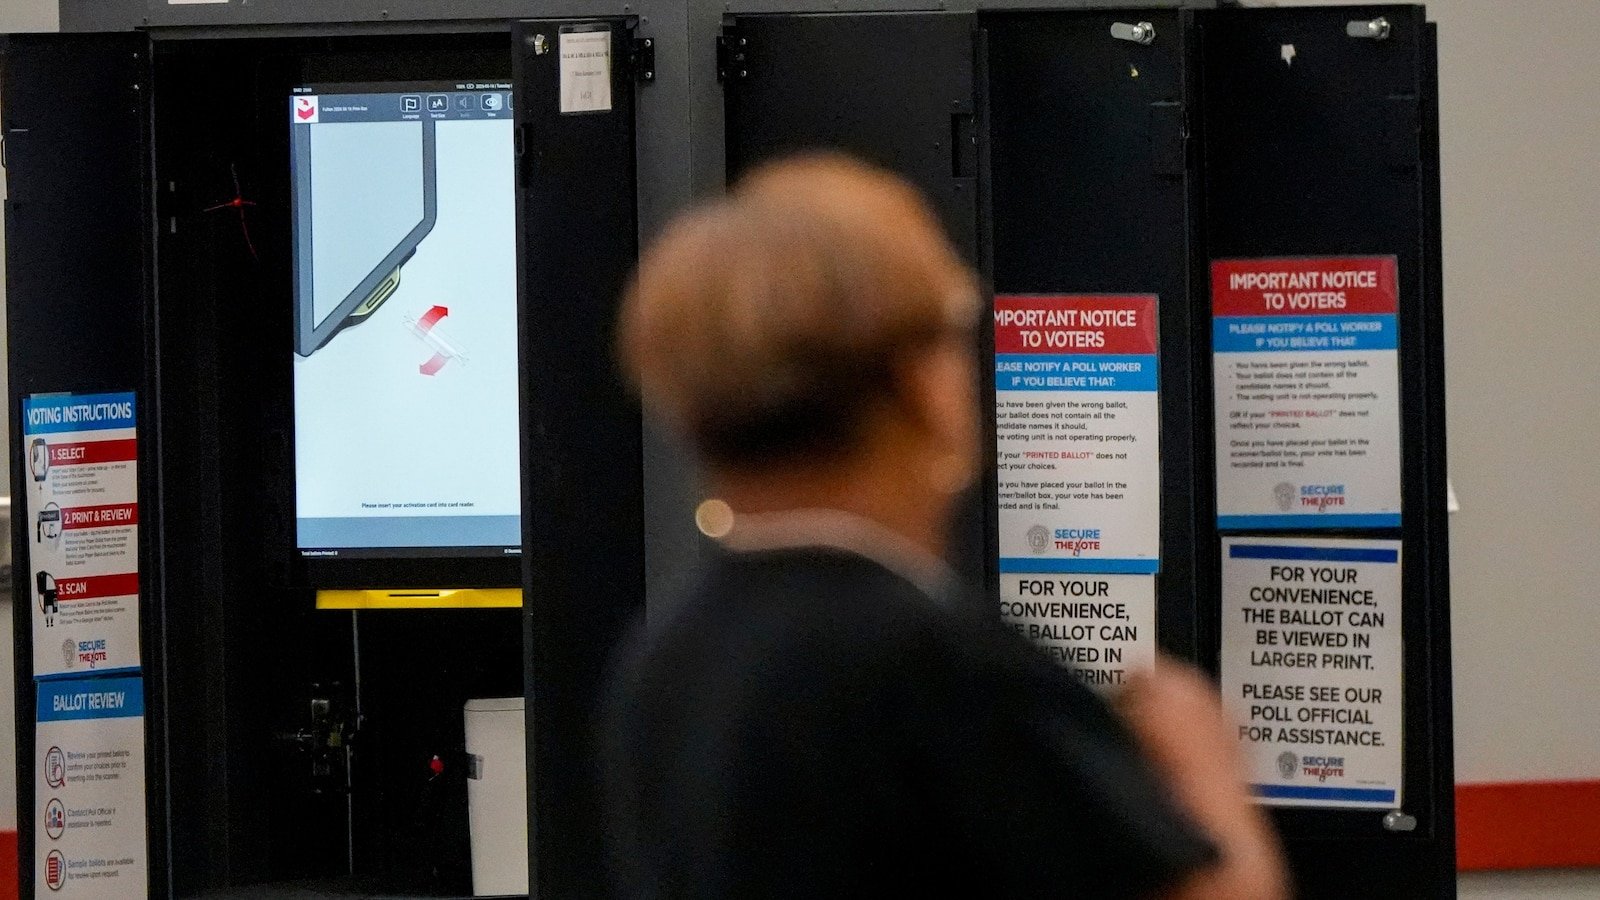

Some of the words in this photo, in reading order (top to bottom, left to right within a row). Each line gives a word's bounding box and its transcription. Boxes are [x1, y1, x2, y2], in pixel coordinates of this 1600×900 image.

[1230, 272, 1318, 290] IMPORTANT
[1322, 271, 1377, 288] NOTICE
[1263, 292, 1284, 310] TO
[1288, 292, 1346, 309] VOTERS
[994, 309, 1077, 327] MPORTANT
[1080, 310, 1136, 327] NOTICE
[1229, 323, 1266, 334] PLEASE
[1268, 322, 1304, 333] NOTIFY
[1306, 322, 1314, 332] A
[1314, 322, 1338, 332] POLL
[1340, 322, 1382, 332] WORKER
[1020, 330, 1042, 348] TO
[1044, 330, 1105, 348] VOTERS
[1267, 337, 1289, 348] YOU
[1290, 336, 1328, 347] BELIEVE
[1024, 362, 1061, 372] NOTIFY
[1063, 362, 1071, 372] A
[1072, 362, 1096, 372] POLL
[1100, 362, 1142, 372] WORKER
[1012, 377, 1022, 386] IF
[1024, 377, 1044, 386] YOU
[1047, 377, 1086, 386] BELIEVE
[27, 406, 62, 426] VOTING
[63, 402, 132, 422] INSTRUCTIONS
[1046, 401, 1066, 410] given
[1082, 402, 1104, 410] wrong
[1006, 433, 1030, 442] voting
[1069, 434, 1104, 442] operating
[52, 450, 56, 460] 1.
[57, 447, 86, 460] SELECT
[1004, 452, 1020, 460] your
[1300, 484, 1345, 495] SECURE
[64, 514, 72, 524] 2.
[72, 512, 94, 524] PRINT
[95, 511, 100, 522] &
[101, 508, 132, 520] REVIEW
[1055, 529, 1100, 539] SECURE
[1270, 566, 1304, 582] FOR
[1310, 567, 1358, 584] YOUR
[58, 584, 65, 596] 3.
[66, 582, 87, 595] SCAN
[1019, 580, 1054, 596] FOR
[1060, 580, 1109, 597] YOUR
[1250, 586, 1378, 608] CONVENIENCE,
[1000, 602, 1130, 622] CONVENIENCE,
[1242, 608, 1275, 624] THE
[1280, 610, 1344, 626] BALLOT
[1348, 612, 1384, 628] CAN
[1029, 624, 1095, 642] BALLOT
[1100, 626, 1137, 642] CAN
[1256, 630, 1278, 646] BE
[1282, 631, 1348, 648] VIEWED
[1353, 633, 1370, 649] IN
[79, 640, 106, 652] SECURE
[1048, 646, 1099, 664] EWED
[1104, 648, 1122, 664] IN
[1251, 650, 1318, 668] LARGER
[1322, 654, 1375, 671] PRINT.
[53, 694, 86, 712] BALLOT
[88, 692, 125, 710] REVIEW
[1242, 684, 1305, 701] PLEASE
[1310, 686, 1340, 702] SEE
[1344, 688, 1383, 704] OUR
[1251, 706, 1292, 722] POLL
[1297, 708, 1374, 725] OFFICIAL
[1238, 726, 1273, 742] FOR
[1277, 728, 1386, 747] ASSISTANCE.
[1302, 756, 1345, 766] SECURE
